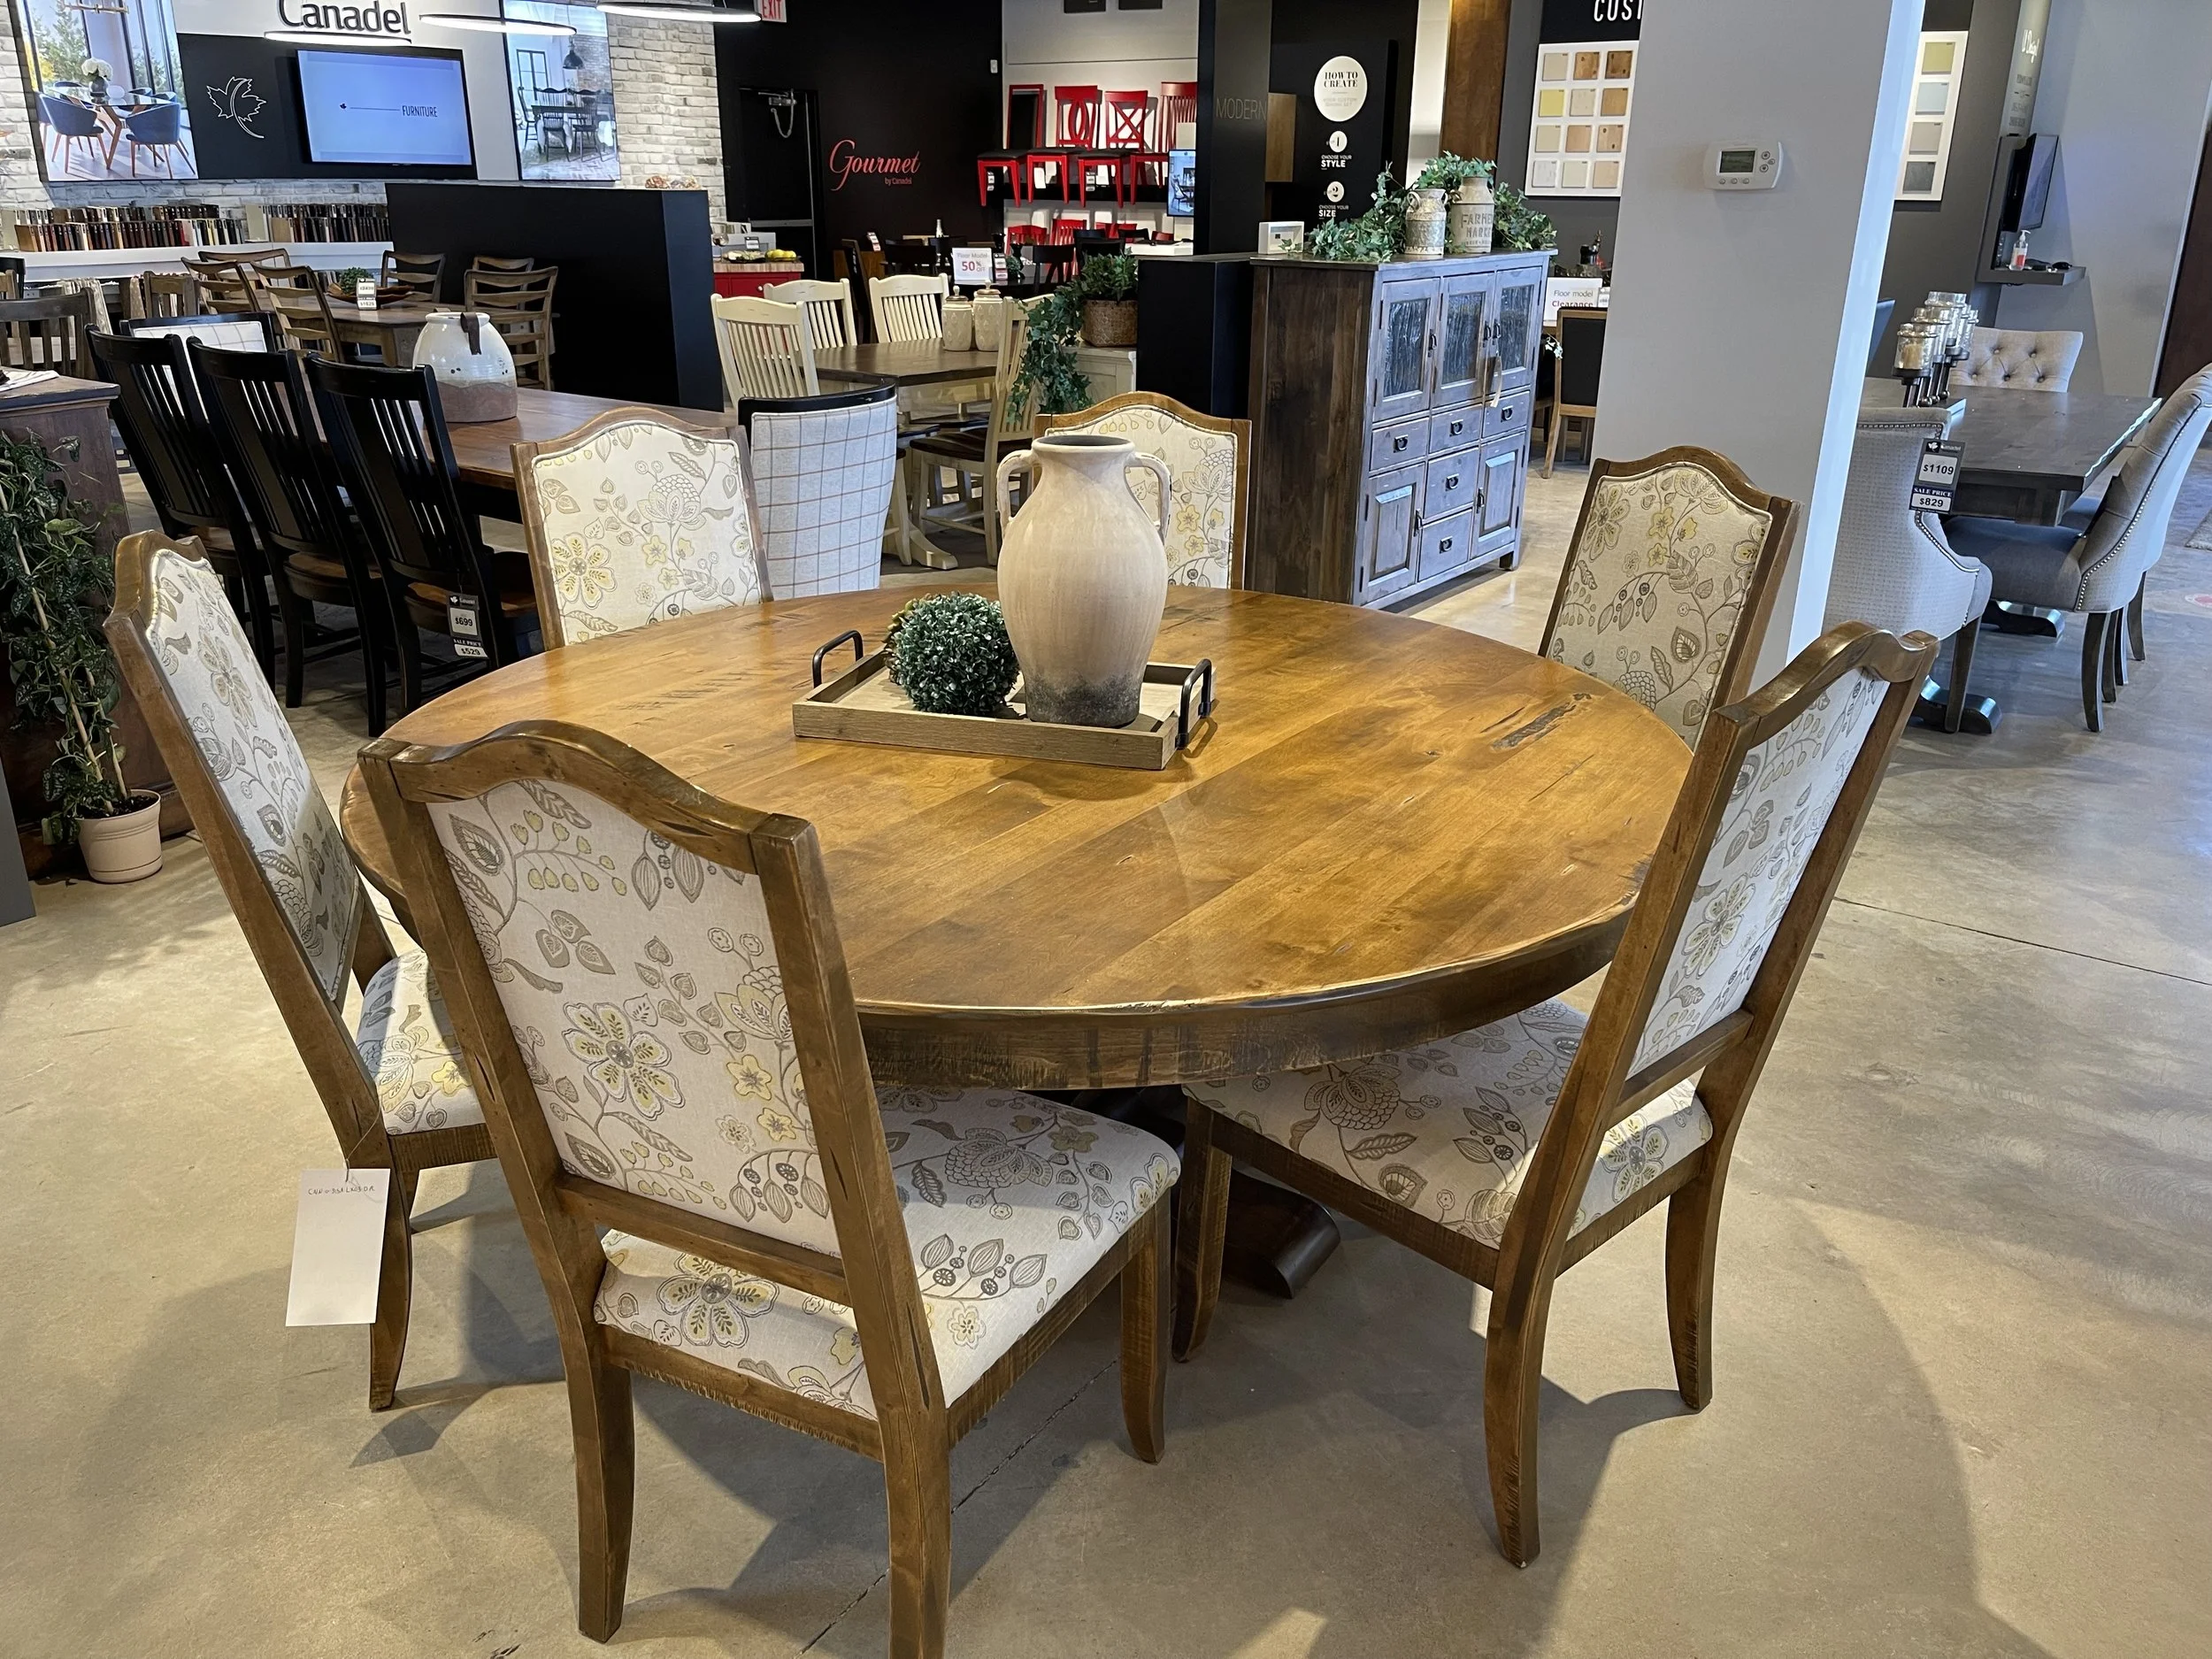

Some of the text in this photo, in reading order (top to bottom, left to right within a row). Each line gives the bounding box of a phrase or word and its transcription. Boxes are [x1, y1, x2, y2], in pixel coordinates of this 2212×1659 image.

[762, 0, 782, 19] EXIT
[278, 0, 412, 35] Canadel
[1346, 71, 1358, 80] TO
[402, 105, 438, 118] FURNITURE
[1216, 97, 1267, 121] MODERN
[829, 139, 921, 191] Gourmet
[1923, 464, 1955, 475] $1109
[1919, 497, 1944, 507] $829
[455, 617, 473, 626] $699
